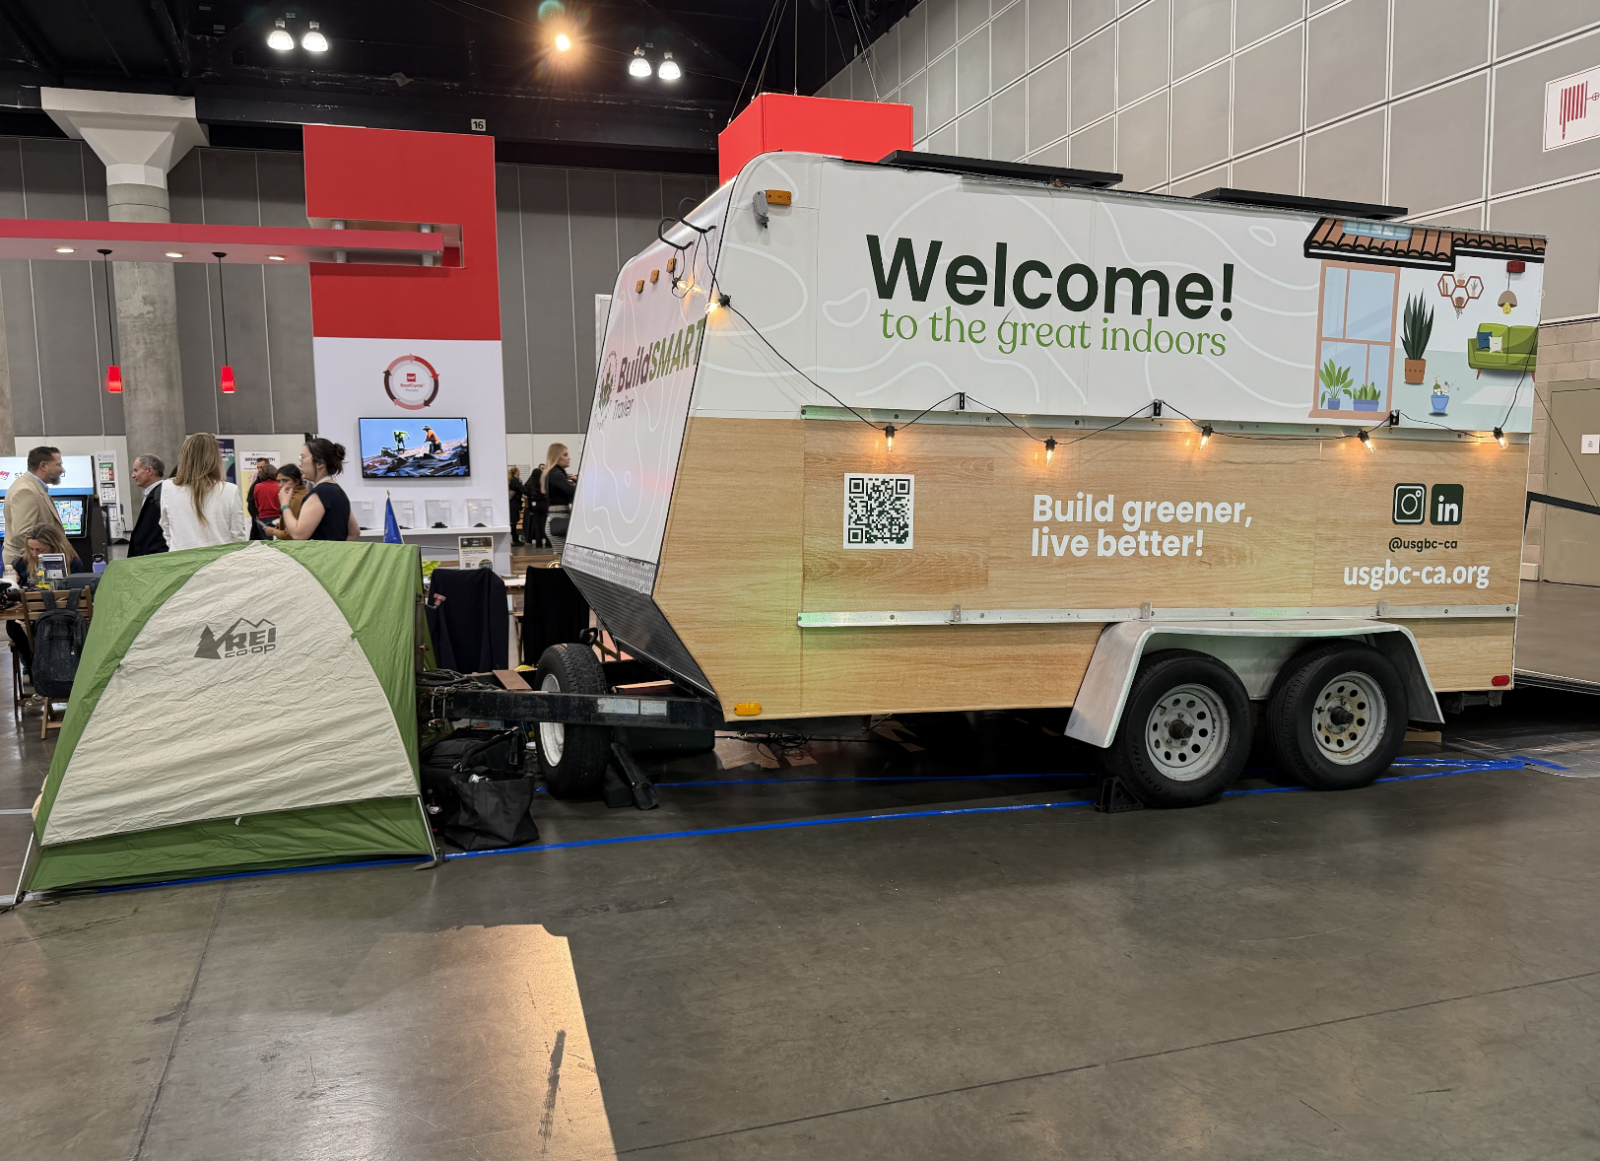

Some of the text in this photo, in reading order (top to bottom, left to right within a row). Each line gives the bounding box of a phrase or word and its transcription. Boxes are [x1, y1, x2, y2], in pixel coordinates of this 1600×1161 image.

[472, 121, 484, 130] 16
[866, 234, 1234, 322] Welcome!
[880, 306, 1227, 356] to the great indoors
[617, 317, 706, 393] BuildSMART
[613, 395, 634, 420] Trailer
[1033, 491, 1253, 532] Build greener,
[1437, 495, 1459, 522] in
[1031, 526, 1204, 557] live better!
[1388, 537, 1458, 552] @usgbc-ca
[1343, 559, 1491, 591] usgbc-ca.org
[225, 627, 277, 651] REI
[1132, 733, 1170, 797] FORTUNE
